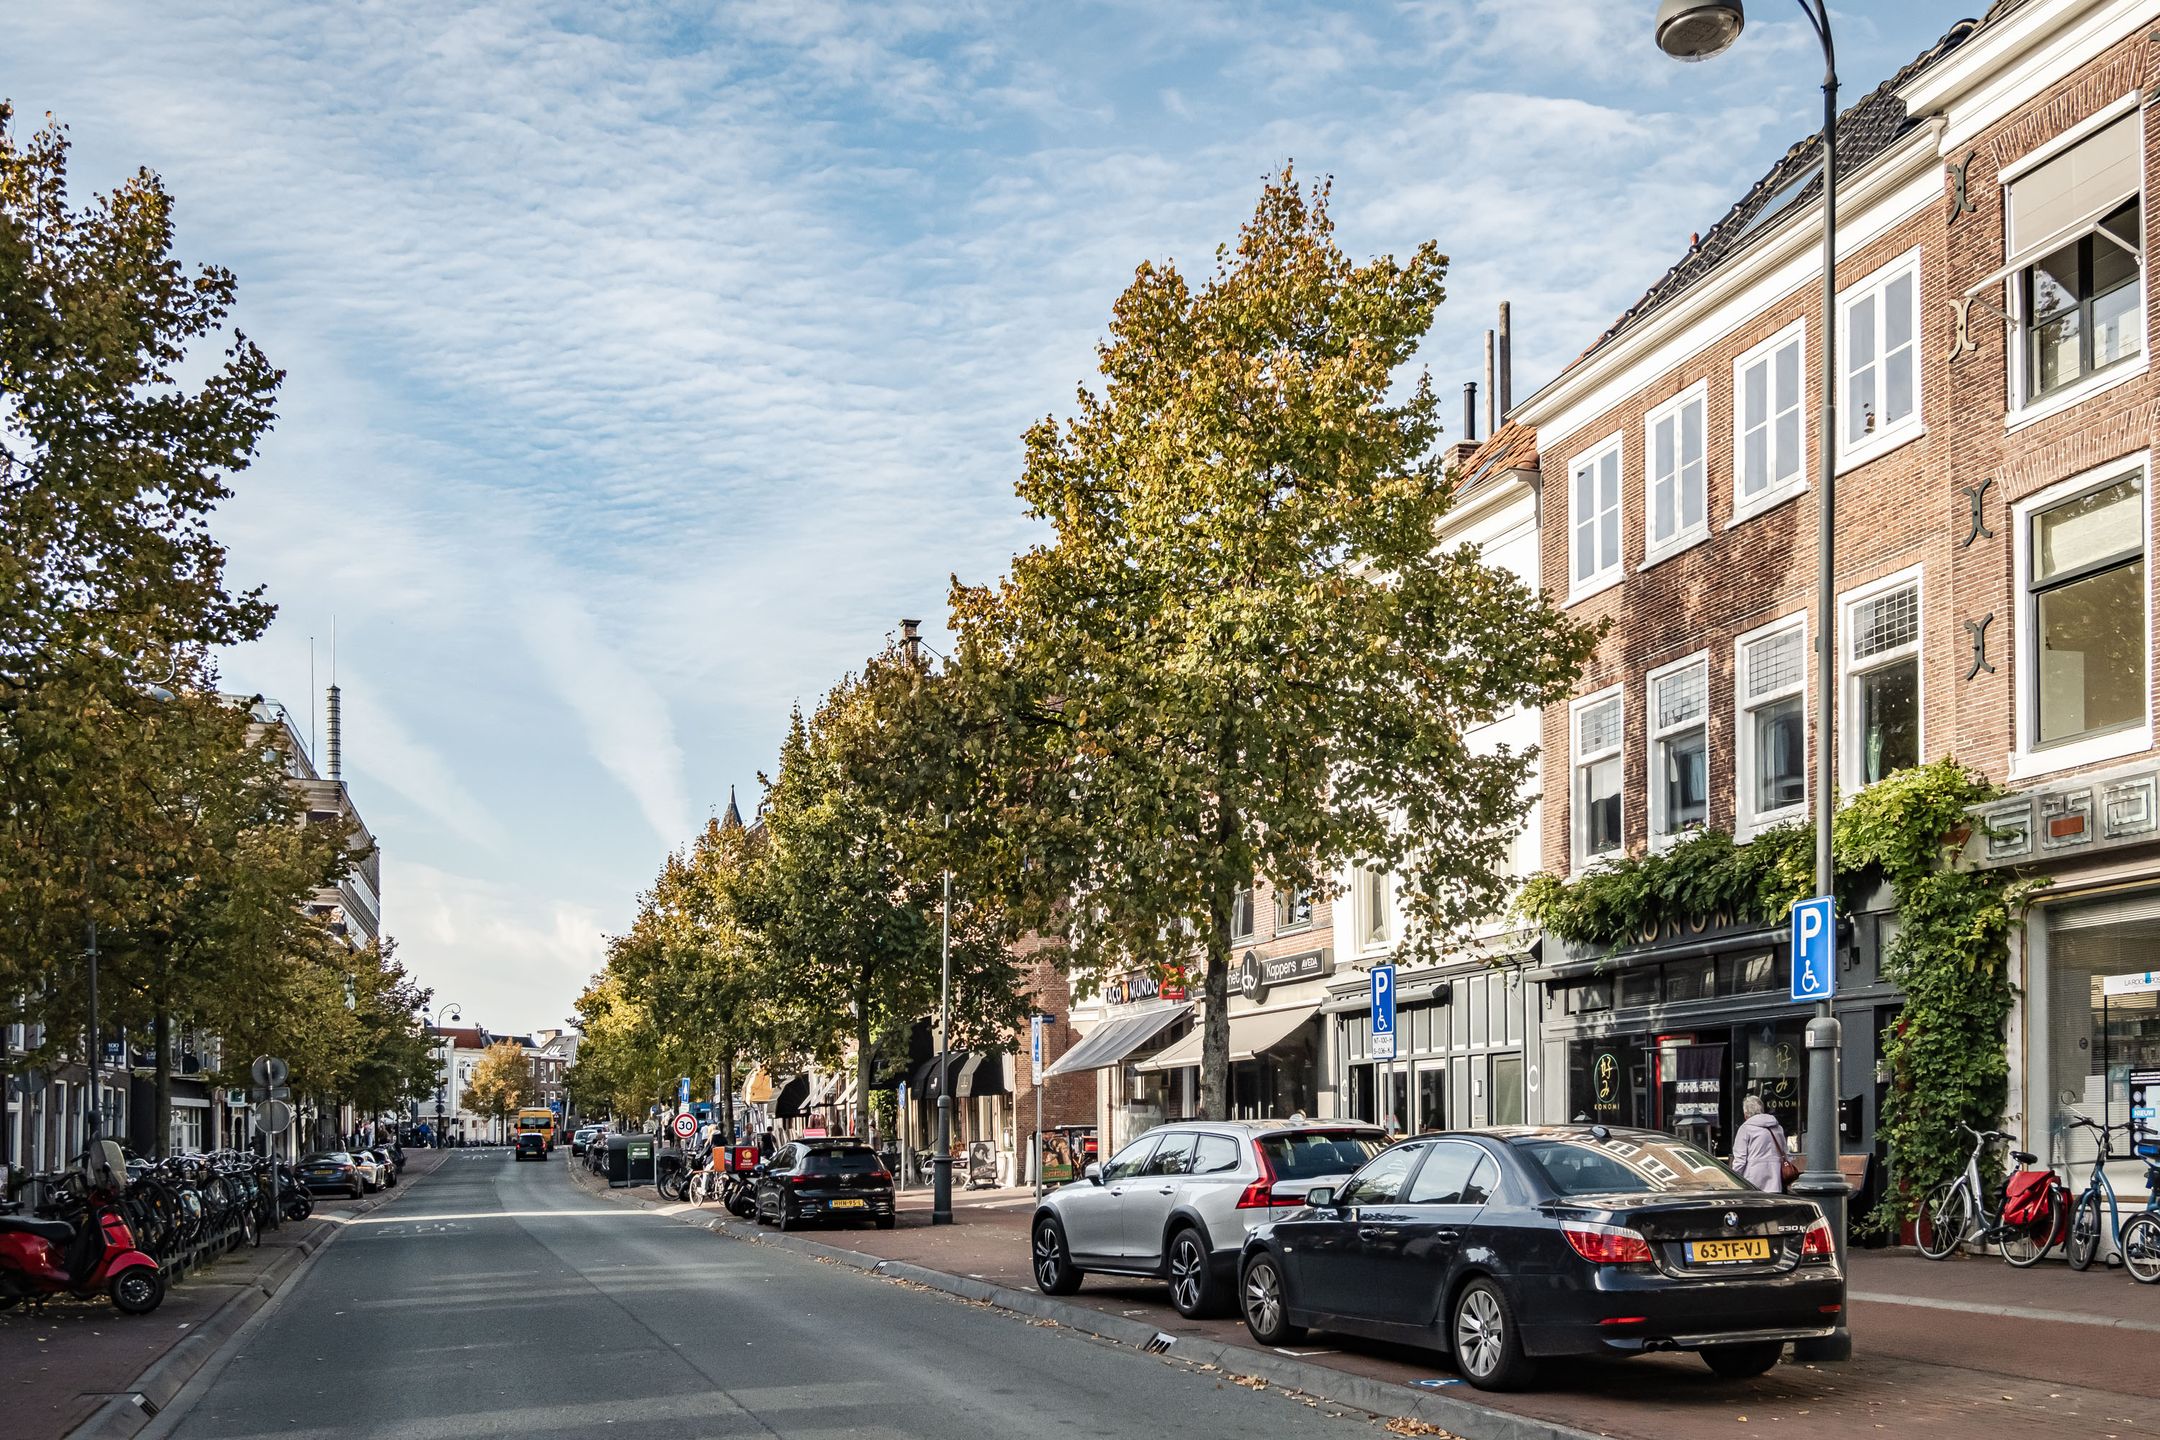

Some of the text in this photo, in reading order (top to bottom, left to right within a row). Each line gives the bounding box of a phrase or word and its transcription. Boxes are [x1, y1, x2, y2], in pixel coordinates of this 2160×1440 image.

[1800, 907, 1823, 957] P
[1266, 956, 1318, 980] Kappers AVEDA
[1375, 971, 1388, 1006] P
[1593, 1103, 1620, 1111] KONOMI
[678, 1120, 693, 1130] 30
[1700, 1240, 1761, 1259] 63-TF-VJ
